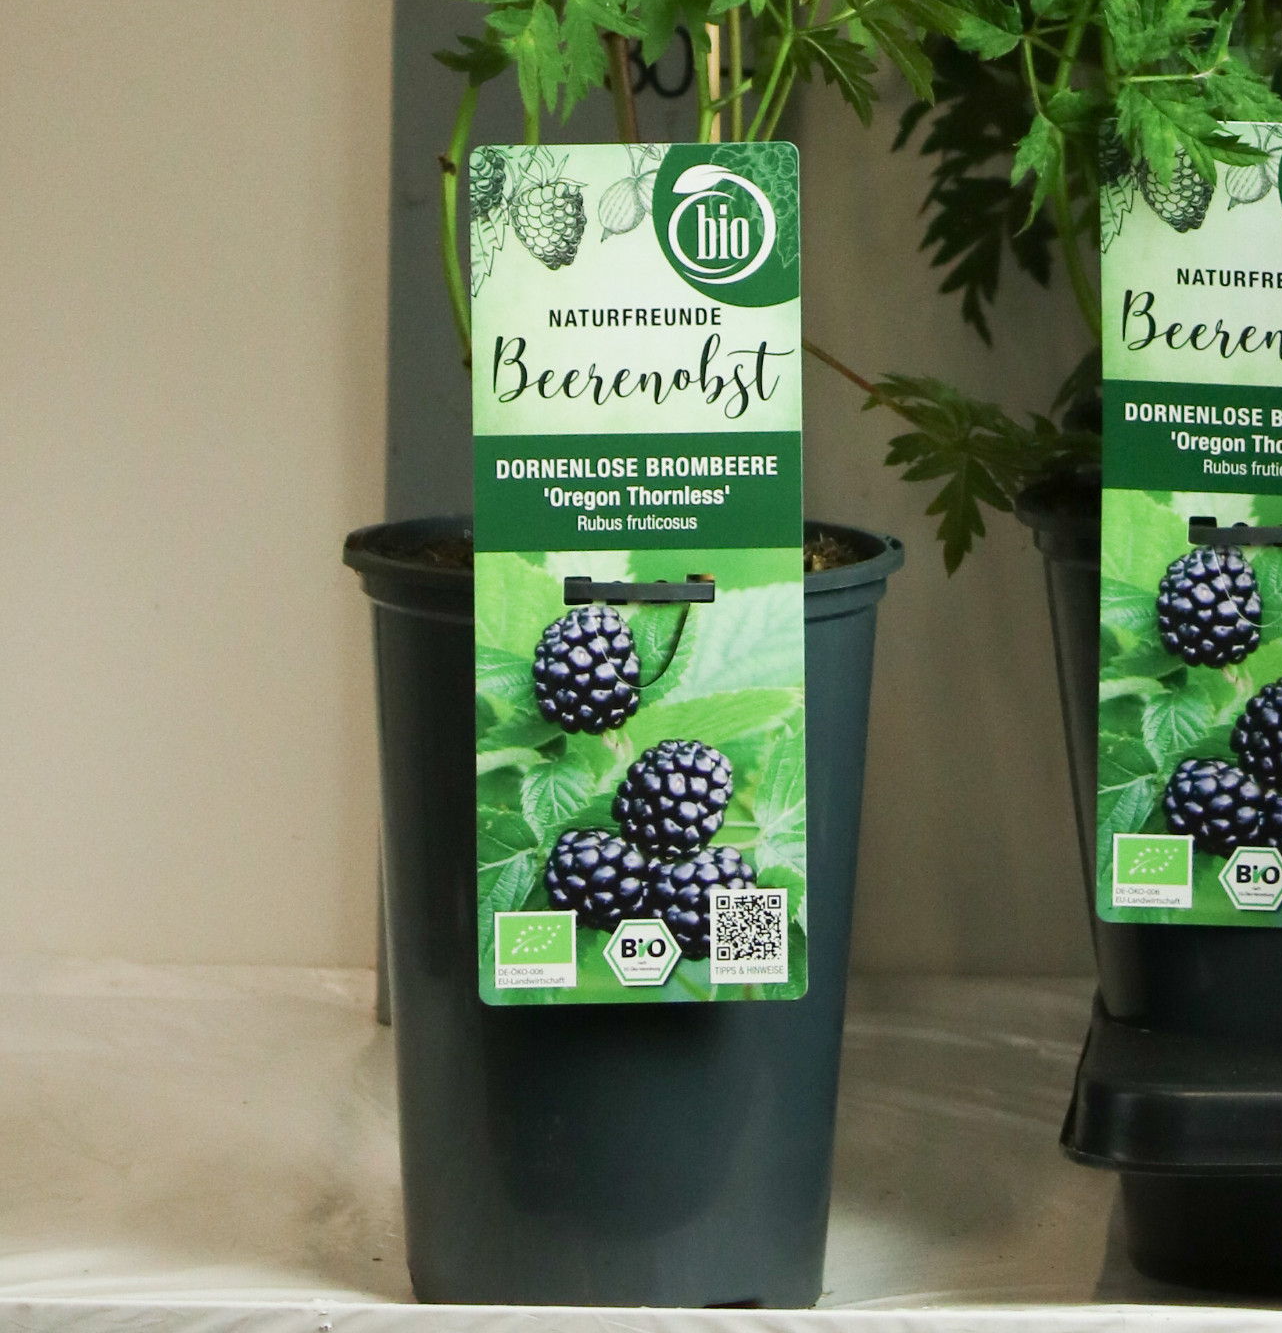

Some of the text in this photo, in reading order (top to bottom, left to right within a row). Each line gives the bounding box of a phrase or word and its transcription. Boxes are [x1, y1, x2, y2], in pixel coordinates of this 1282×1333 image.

[695, 203, 749, 260] bio
[549, 307, 722, 327] NATURFREUNDE
[493, 334, 794, 419] Beerenobst
[1125, 403, 1262, 426] DORNENLOSE
[1172, 432, 1245, 455] 'Oregon
[497, 456, 777, 479] DORNENLOSE BROMBEERE
[1204, 459, 1247, 475] Rubus
[544, 485, 729, 510] 'Oregon Thornless'
[578, 515, 697, 530] Rubus fruticosus
[498, 976, 565, 985] EU-Landwirtschaft
[715, 965, 784, 975] TIPPS & HINWEISE
